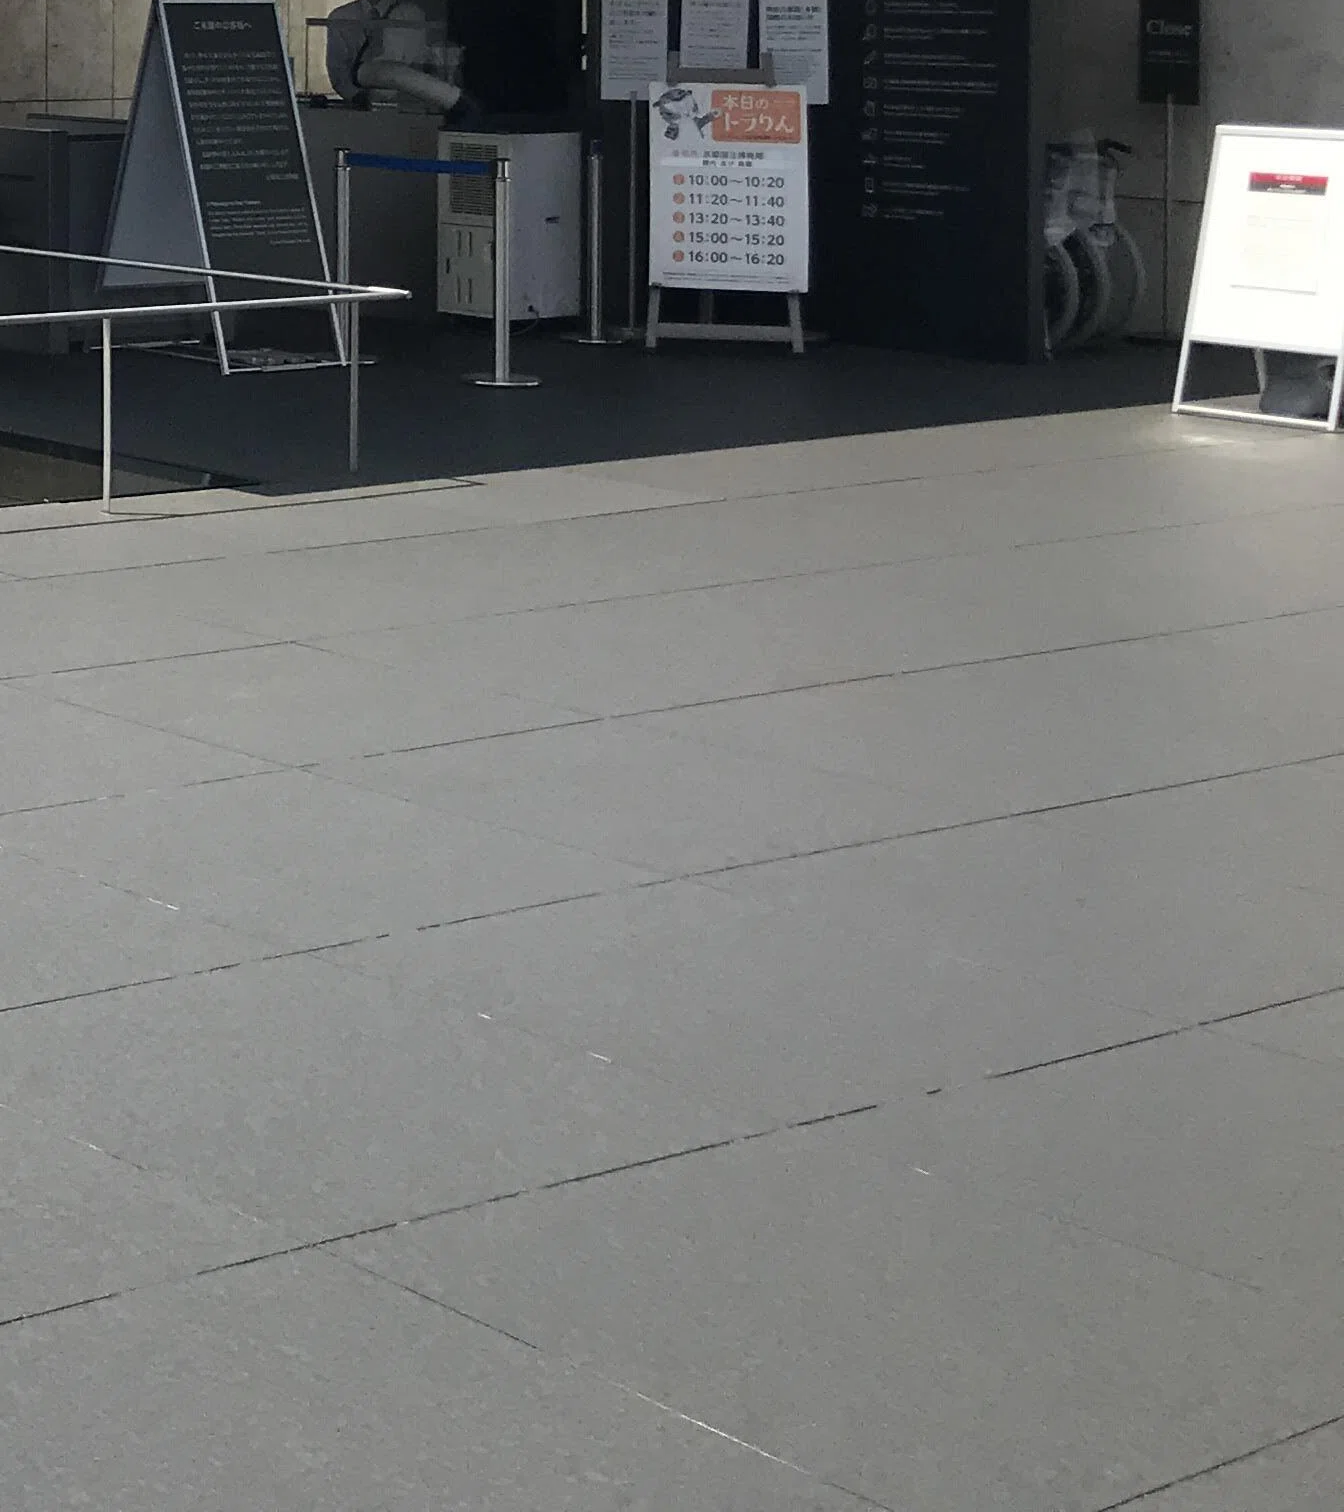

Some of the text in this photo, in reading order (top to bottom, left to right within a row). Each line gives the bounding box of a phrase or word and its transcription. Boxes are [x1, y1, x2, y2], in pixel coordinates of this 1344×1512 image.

[723, 94, 769, 110] 本日の
[723, 112, 795, 134] トラりん
